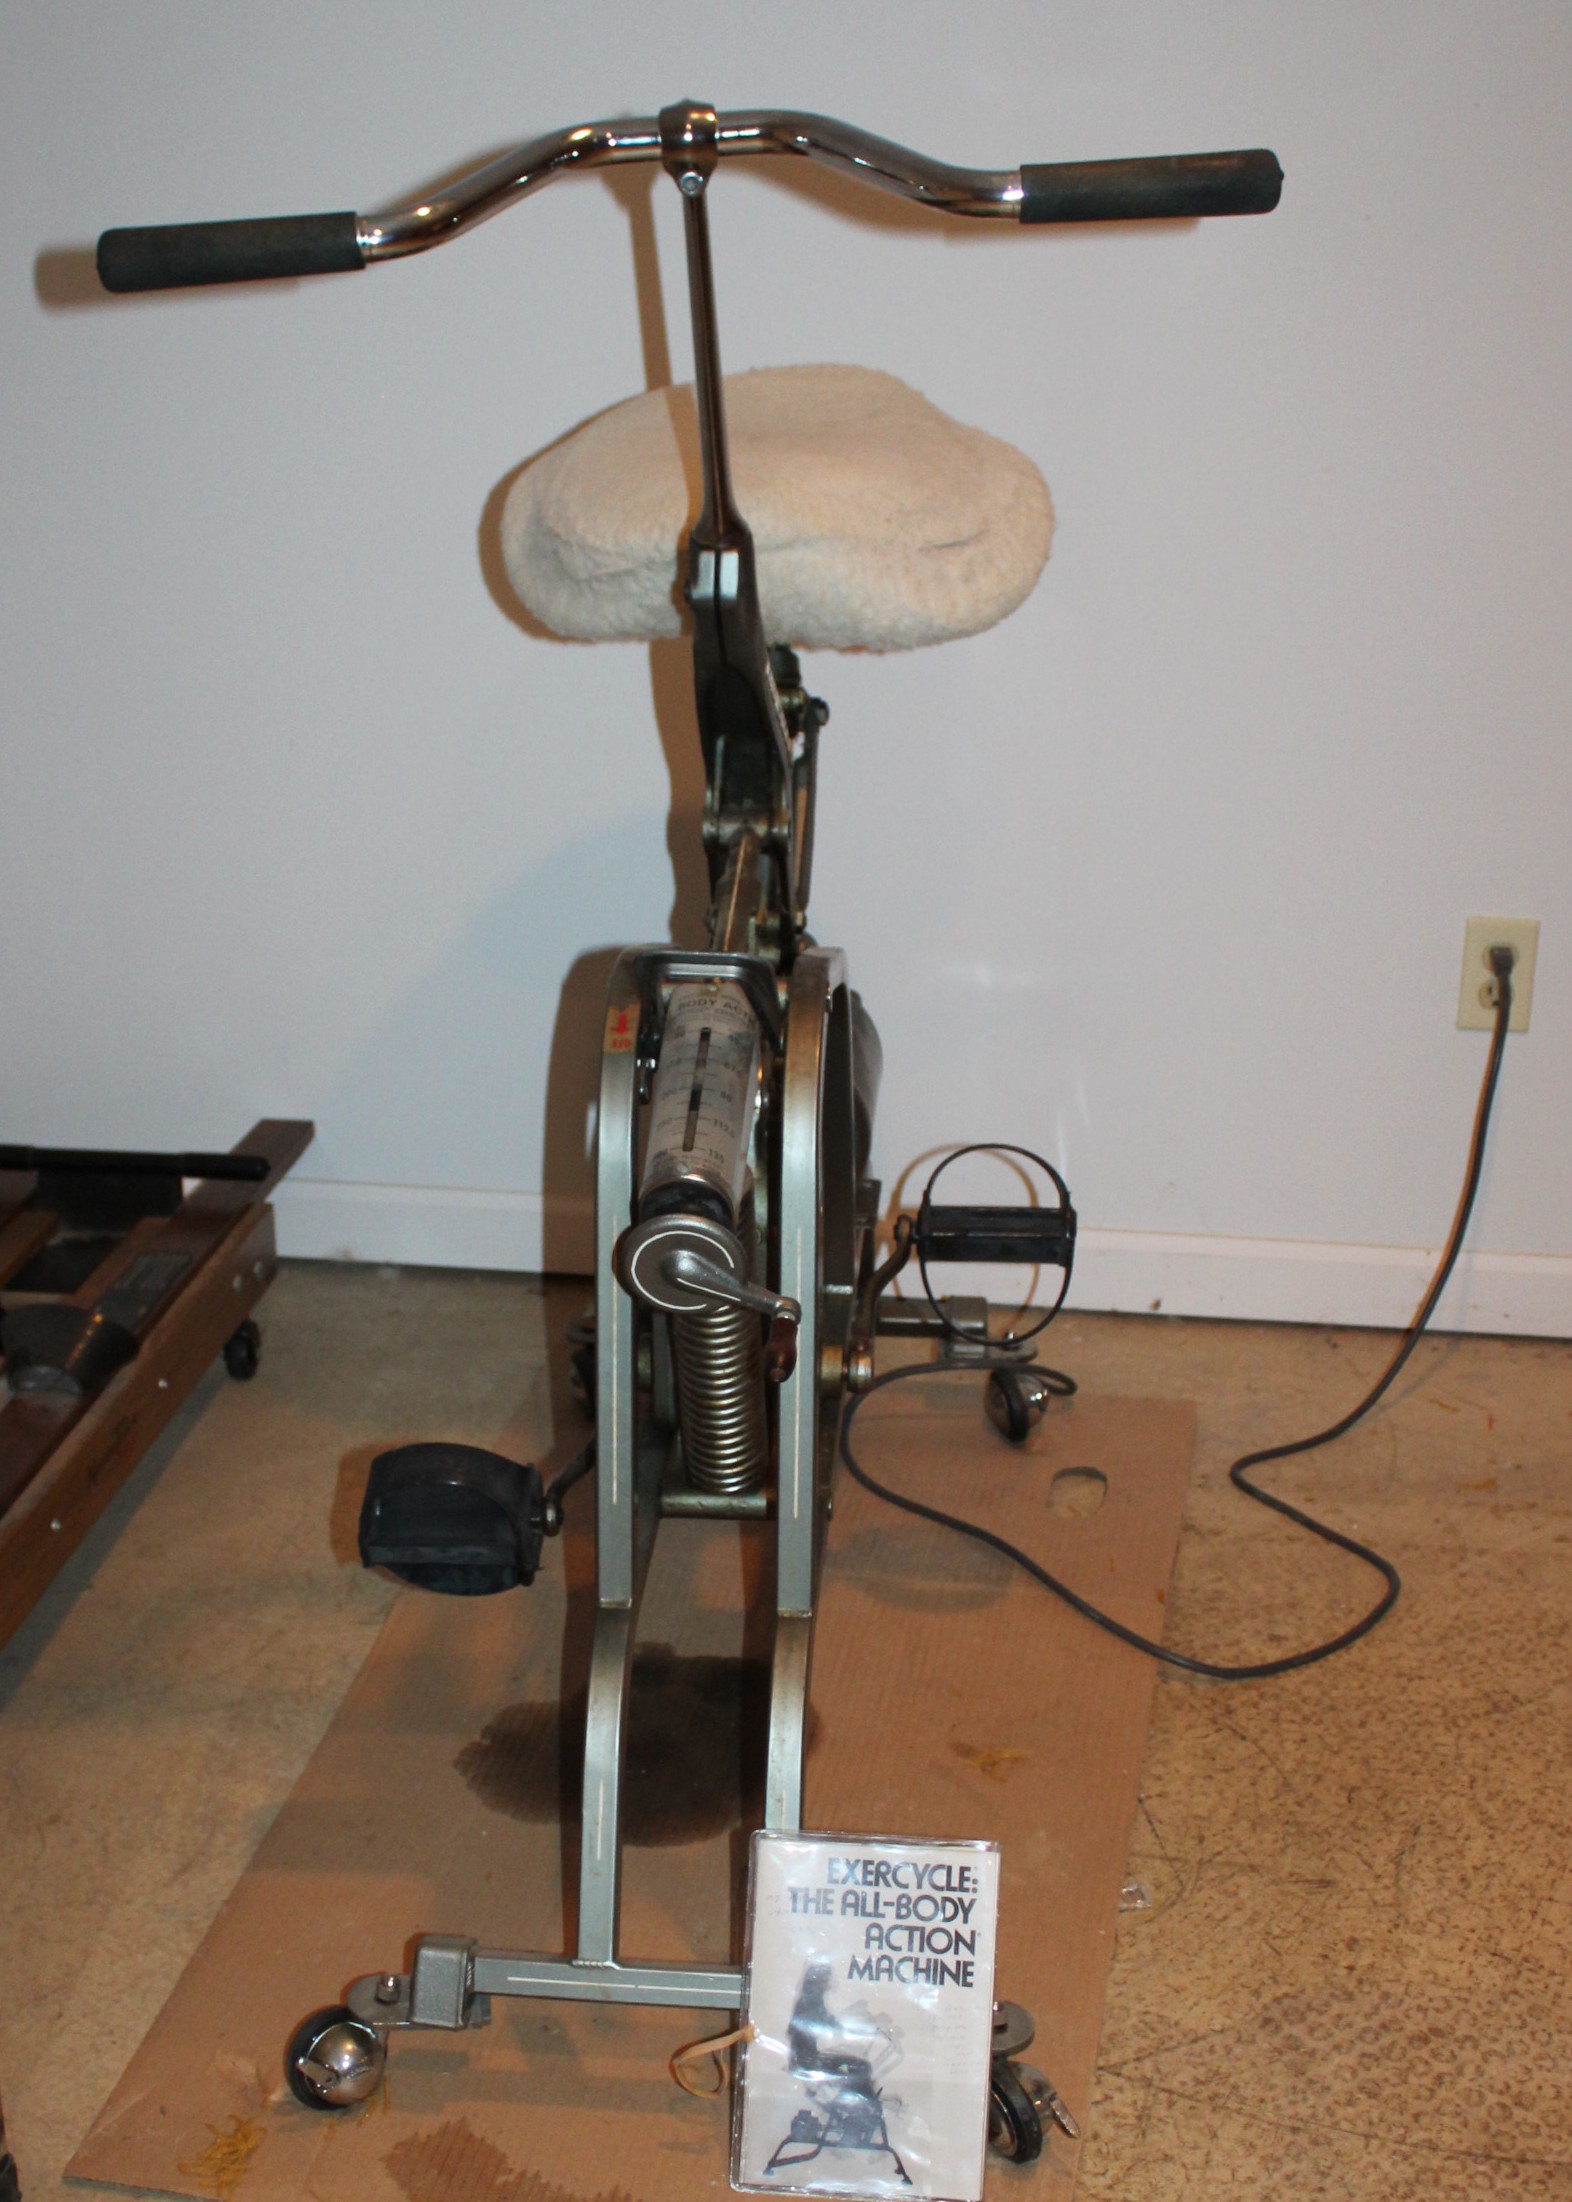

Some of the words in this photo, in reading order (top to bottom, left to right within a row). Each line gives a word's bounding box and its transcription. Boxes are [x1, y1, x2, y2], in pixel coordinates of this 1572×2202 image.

[827, 1857, 978, 1894] EXERCYCLE:
[788, 1887, 834, 1916] THE
[841, 1889, 977, 1924] ALL-BODY
[864, 1922, 976, 1956] ACTION
[847, 1955, 974, 1988] MACHINE
